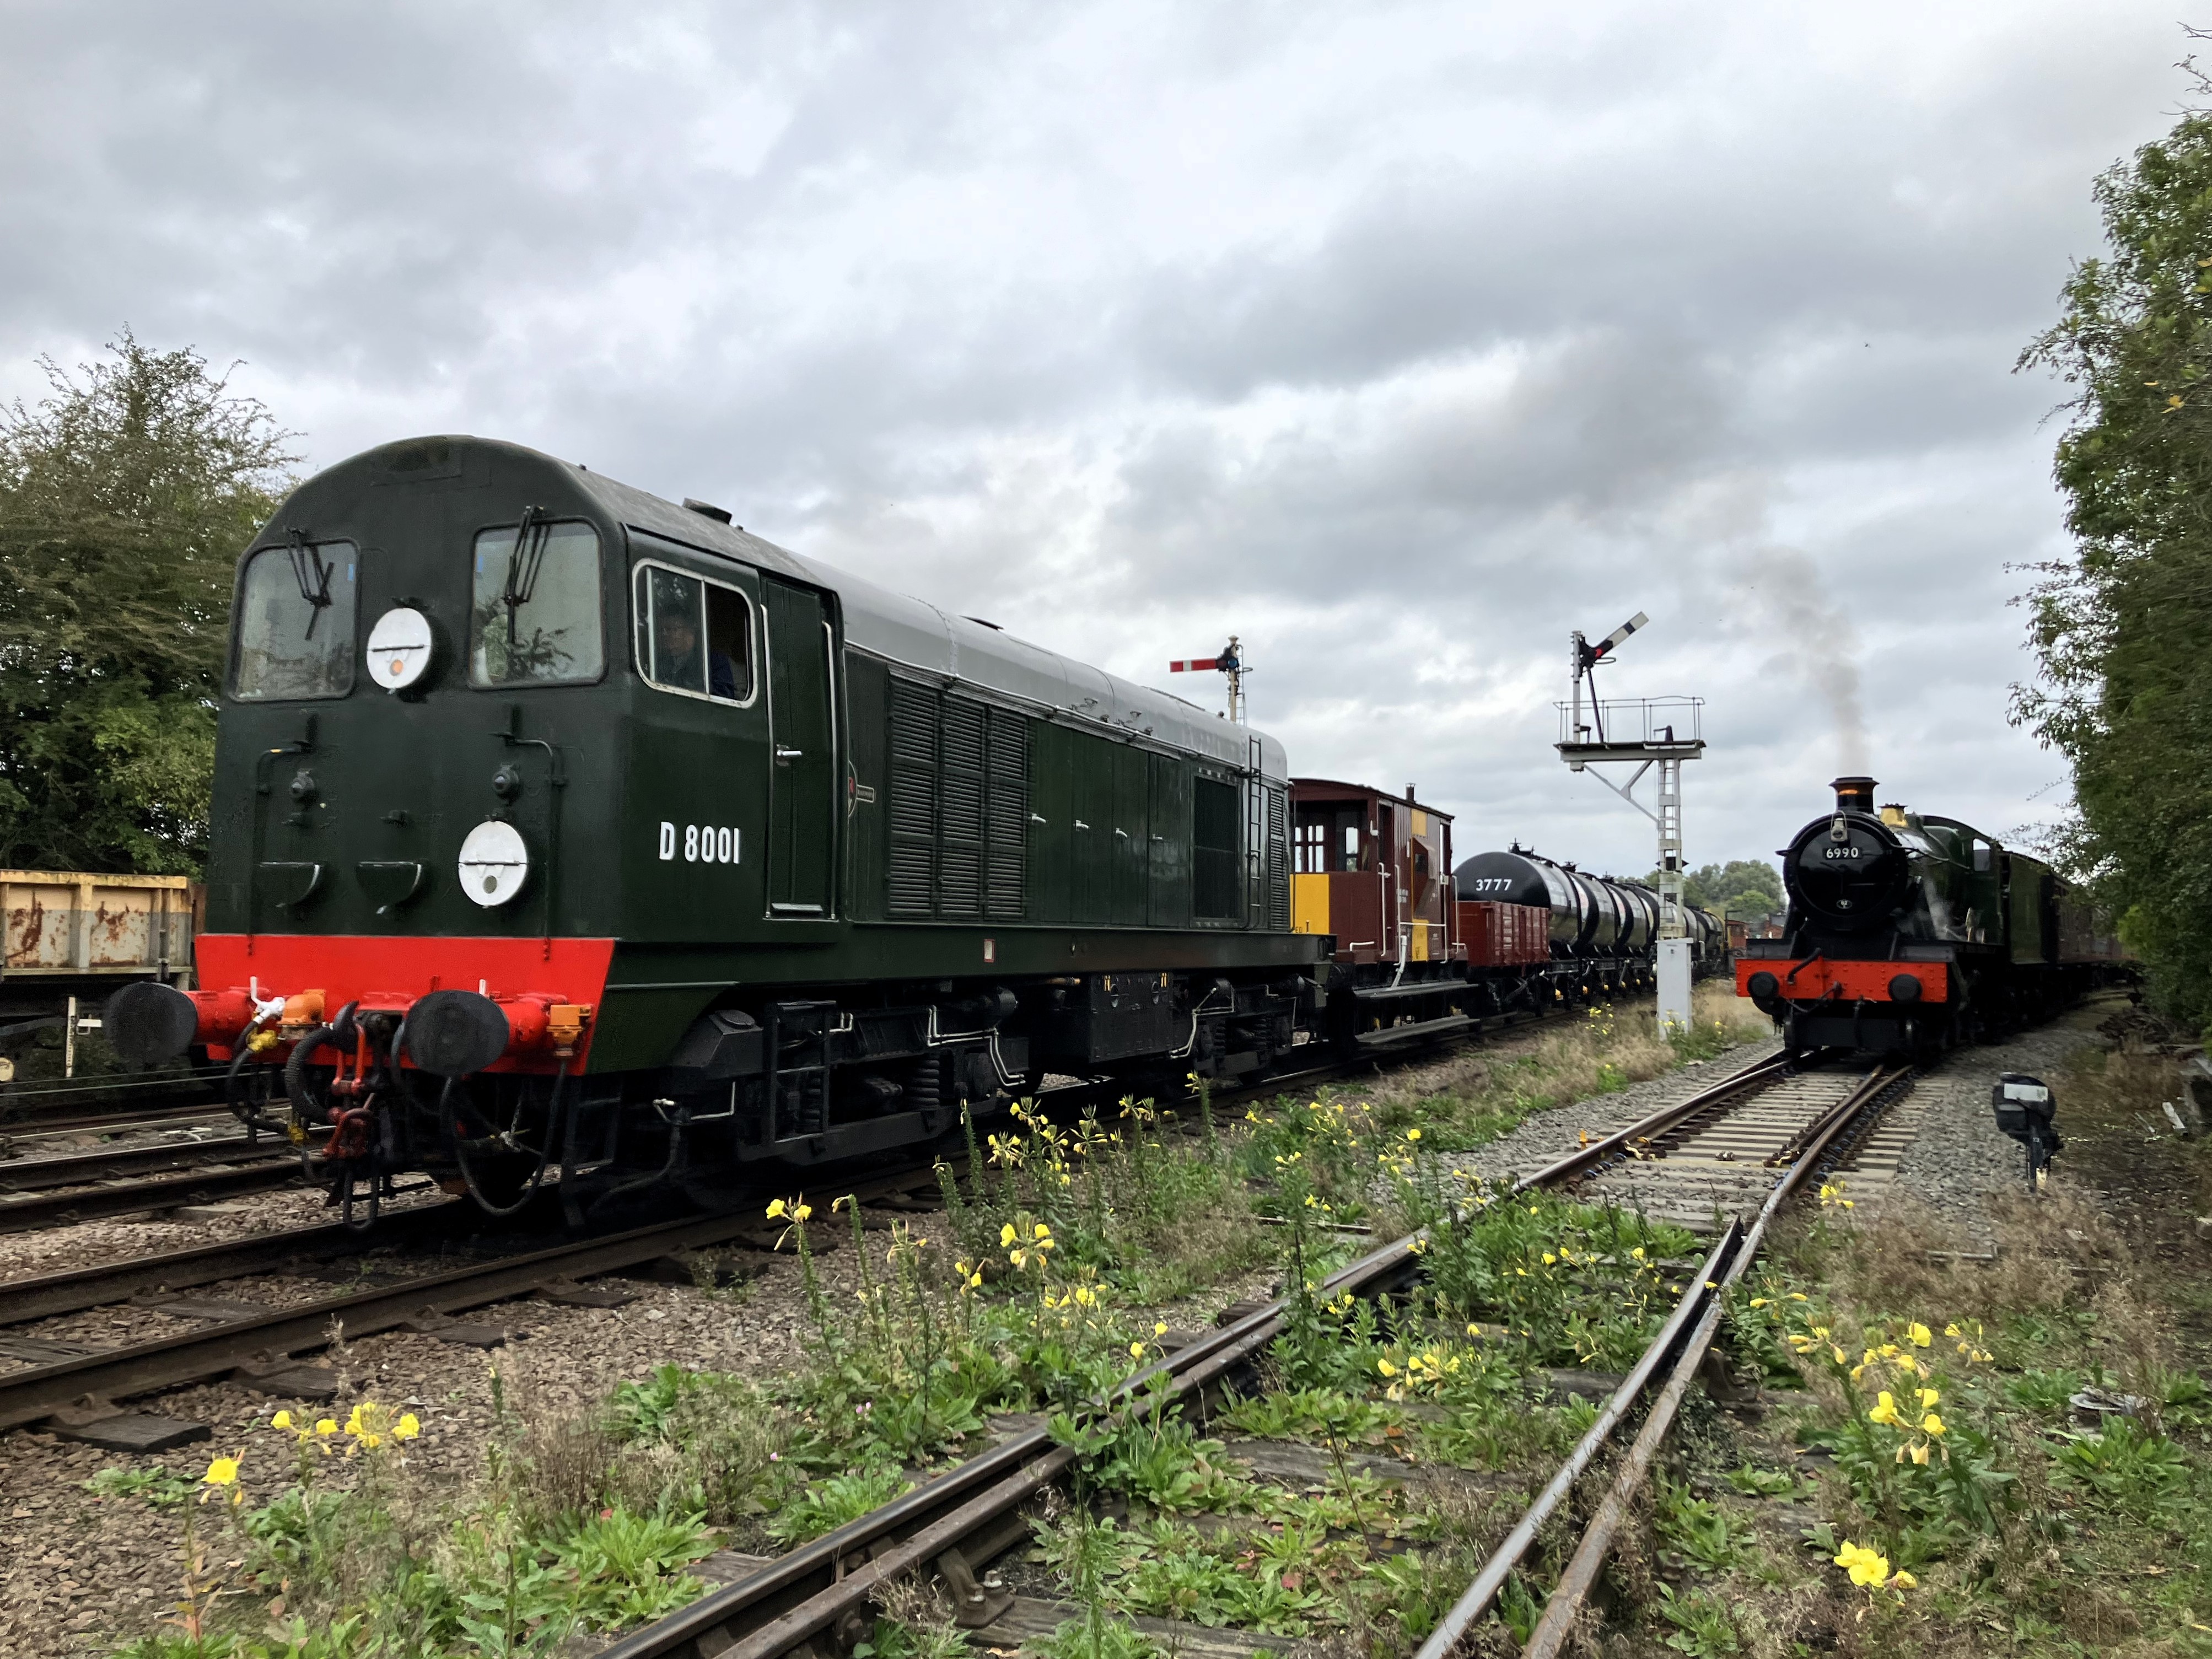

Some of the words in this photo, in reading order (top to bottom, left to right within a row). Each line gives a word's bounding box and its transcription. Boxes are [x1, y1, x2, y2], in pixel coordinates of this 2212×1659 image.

[659, 821, 675, 860] D
[685, 825, 740, 864] 8001
[1826, 847, 1859, 859] 6990
[1476, 879, 1512, 891] 3777
